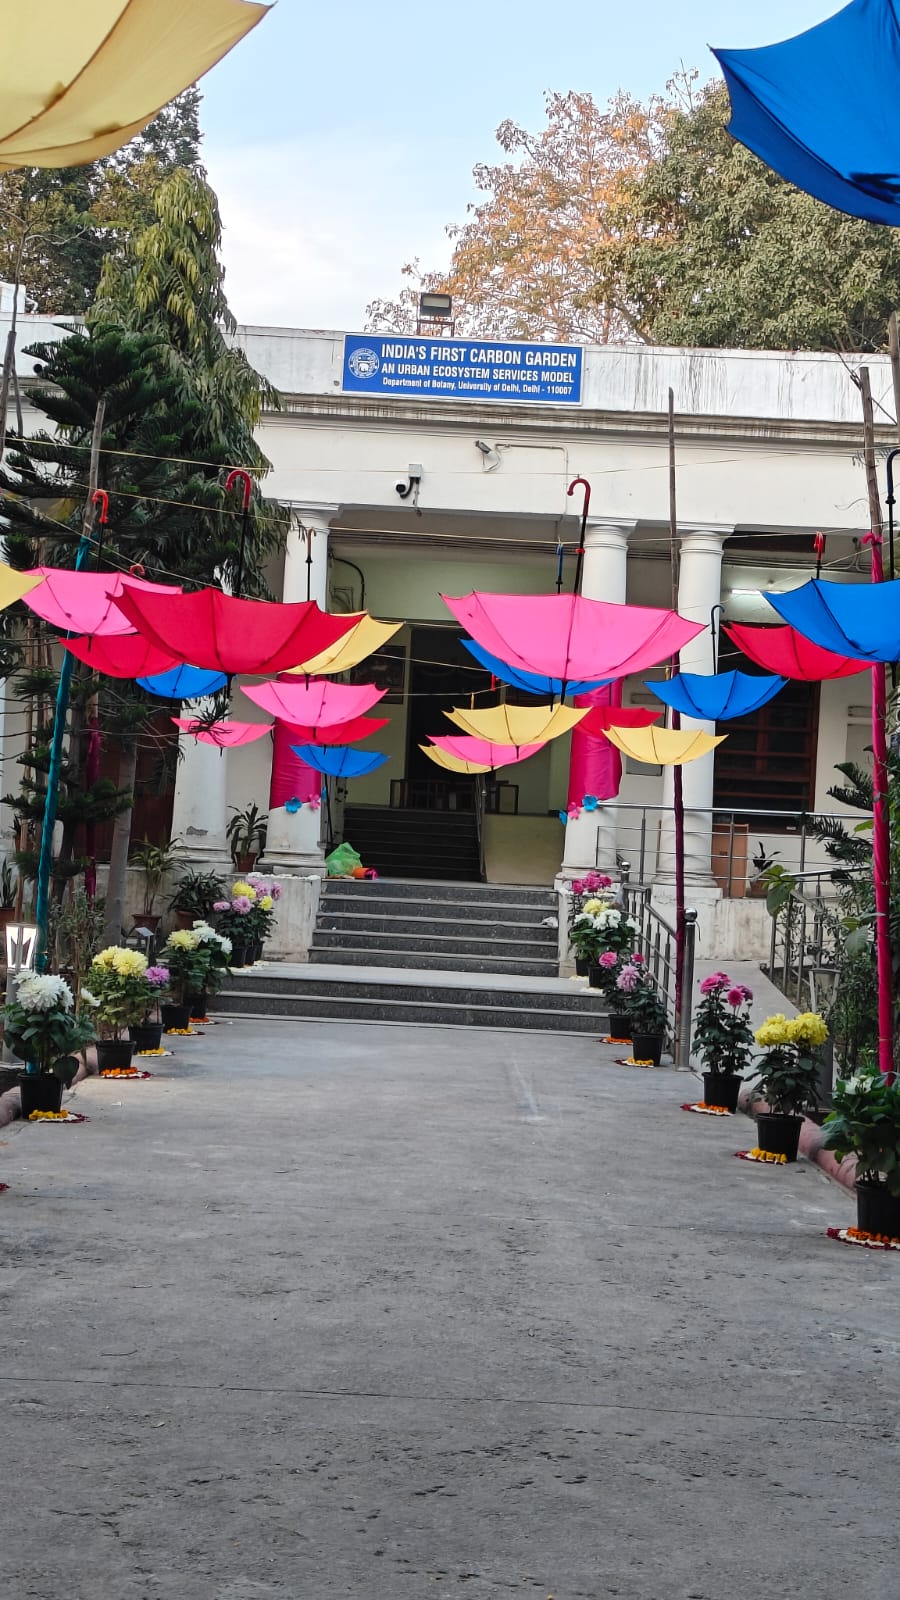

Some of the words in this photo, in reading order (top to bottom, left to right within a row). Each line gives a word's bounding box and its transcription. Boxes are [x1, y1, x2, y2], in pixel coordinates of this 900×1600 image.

[382, 344, 426, 360] INDIA'S
[431, 346, 466, 362] FIRST
[470, 348, 521, 364] CARBON
[525, 351, 576, 367] GARDEN
[382, 363, 395, 374] AN
[398, 364, 430, 376] URBAN
[433, 366, 490, 379] ECOSYSTEM
[493, 369, 538, 381] SERVICES
[541, 371, 574, 383] MODEL
[383, 377, 421, 387] Department
[424, 379, 430, 387] of
[432, 380, 456, 390] Botany,
[458, 381, 491, 392] University
[493, 383, 500, 391] of
[502, 383, 521, 393] Delhi,
[523, 384, 540, 393] Delhi
[547, 386, 572, 395] 110007
